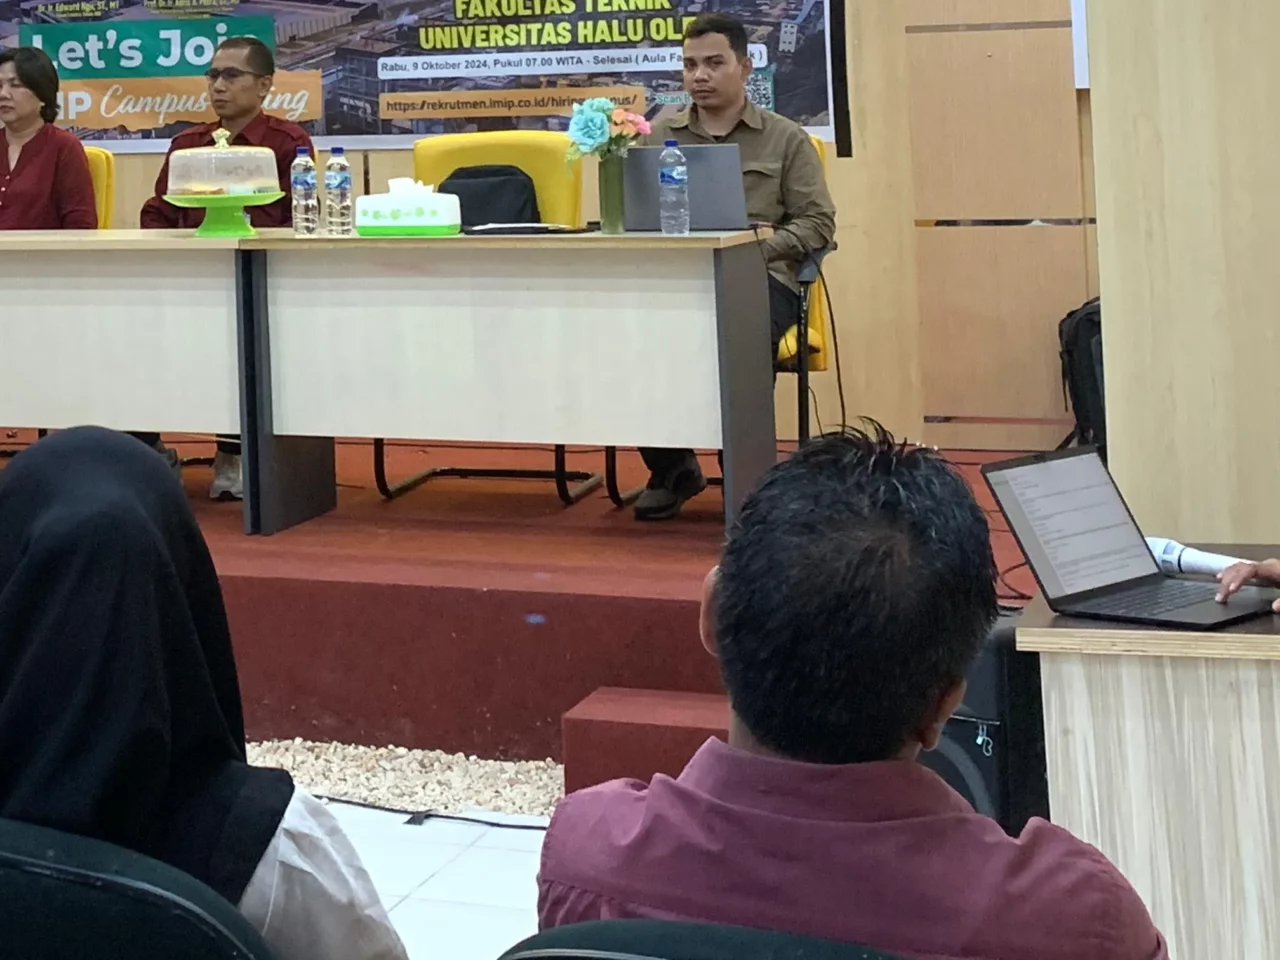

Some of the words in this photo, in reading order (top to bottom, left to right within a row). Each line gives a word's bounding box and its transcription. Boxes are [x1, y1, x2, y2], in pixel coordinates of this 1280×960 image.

[419, 21, 572, 50] UNIVERSITAS
[578, 19, 644, 44] HALU
[381, 62, 410, 72] Rabu,
[413, 63, 418, 71] 9
[421, 61, 461, 71] Oktober
[464, 59, 491, 70] 2024,
[493, 57, 522, 68] Pukul
[525, 57, 553, 68] 07.00
[556, 56, 583, 67] WITA
[593, 54, 632, 65] Selesai
[642, 53, 666, 64] Aula
[101, 84, 210, 123] Campus
